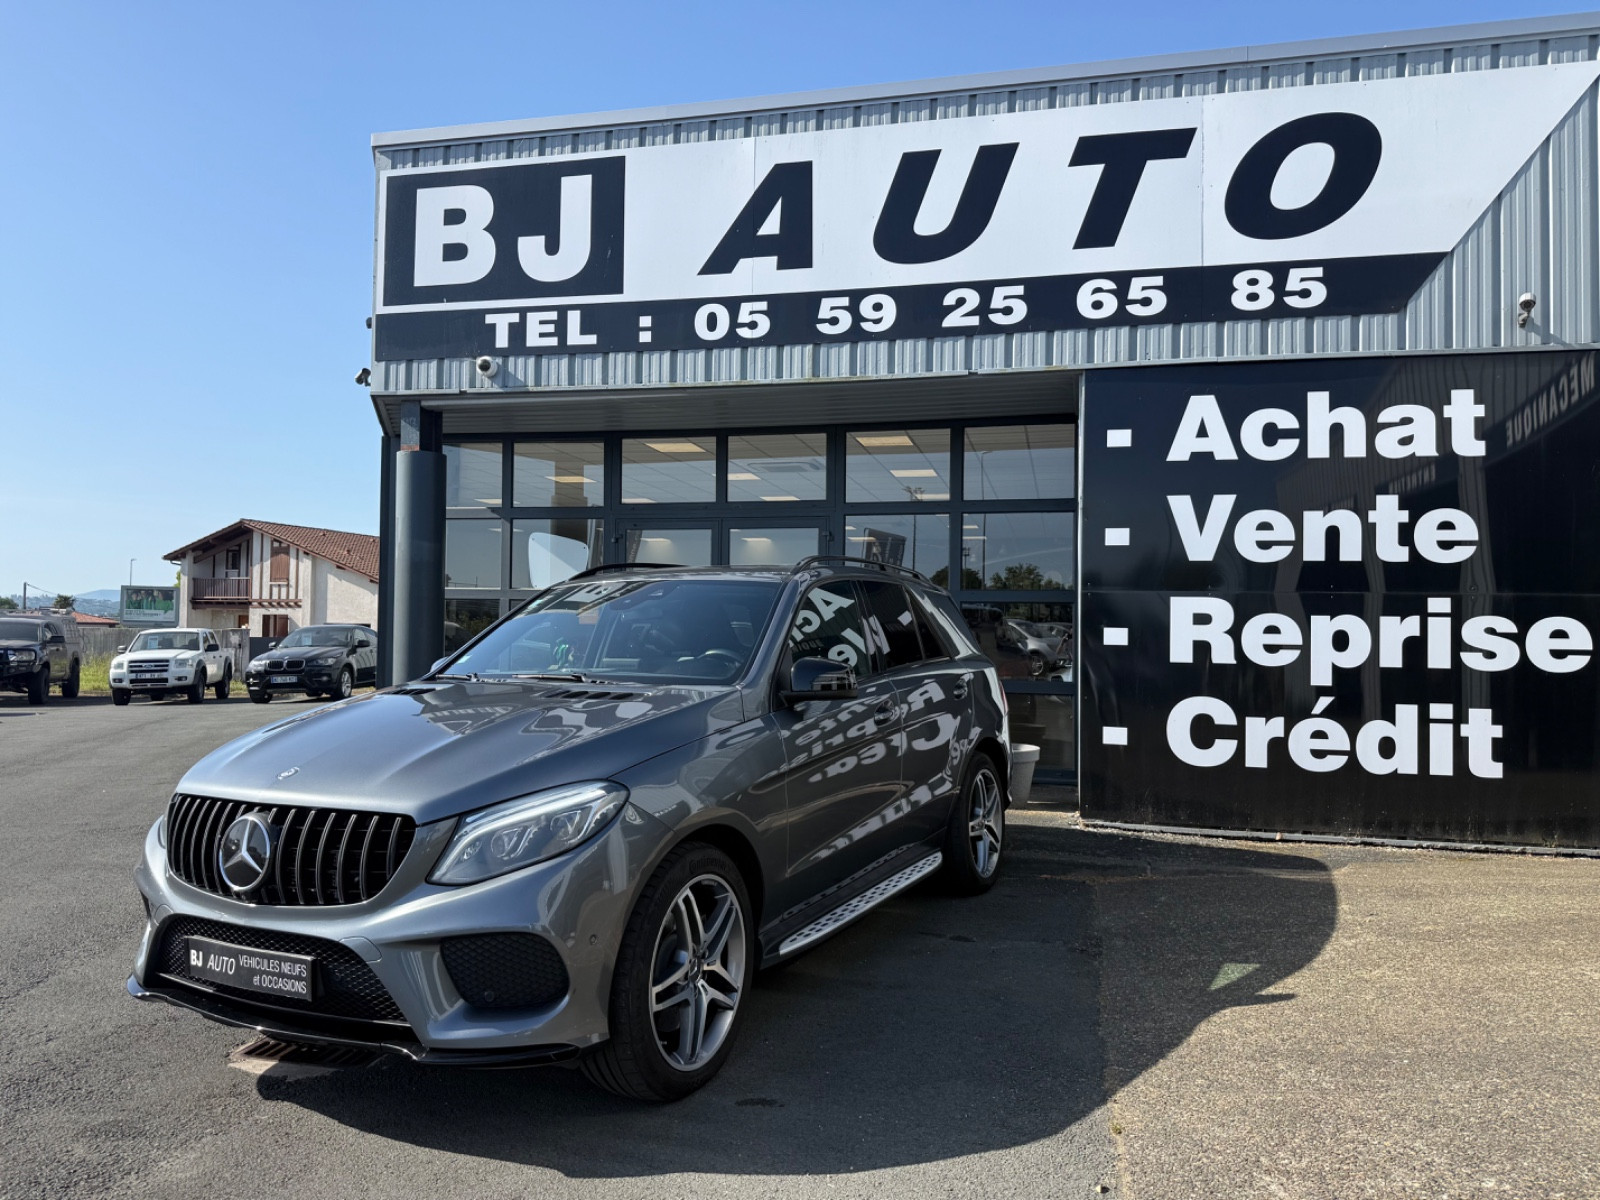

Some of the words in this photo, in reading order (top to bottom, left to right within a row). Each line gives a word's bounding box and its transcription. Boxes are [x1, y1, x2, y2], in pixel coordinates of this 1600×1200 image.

[414, 174, 592, 287] BJ
[697, 112, 1382, 276] AUTO
[484, 310, 598, 349] TEL
[695, 301, 770, 341] 05
[816, 294, 896, 335] 59
[942, 285, 1027, 328] 25
[1077, 276, 1167, 320] 65
[1231, 267, 1327, 311] 85
[1167, 389, 1486, 462] Achat
[1167, 495, 1479, 563] Vente
[1170, 597, 1593, 687] Reprise
[1167, 697, 1503, 779] Crédit
[190, 950, 203, 967] BJ
[207, 954, 236, 975] AUTO
[253, 974, 260, 986] et
[262, 974, 307, 994] OCCASIONS
[280, 961, 307, 978] NEUFS
